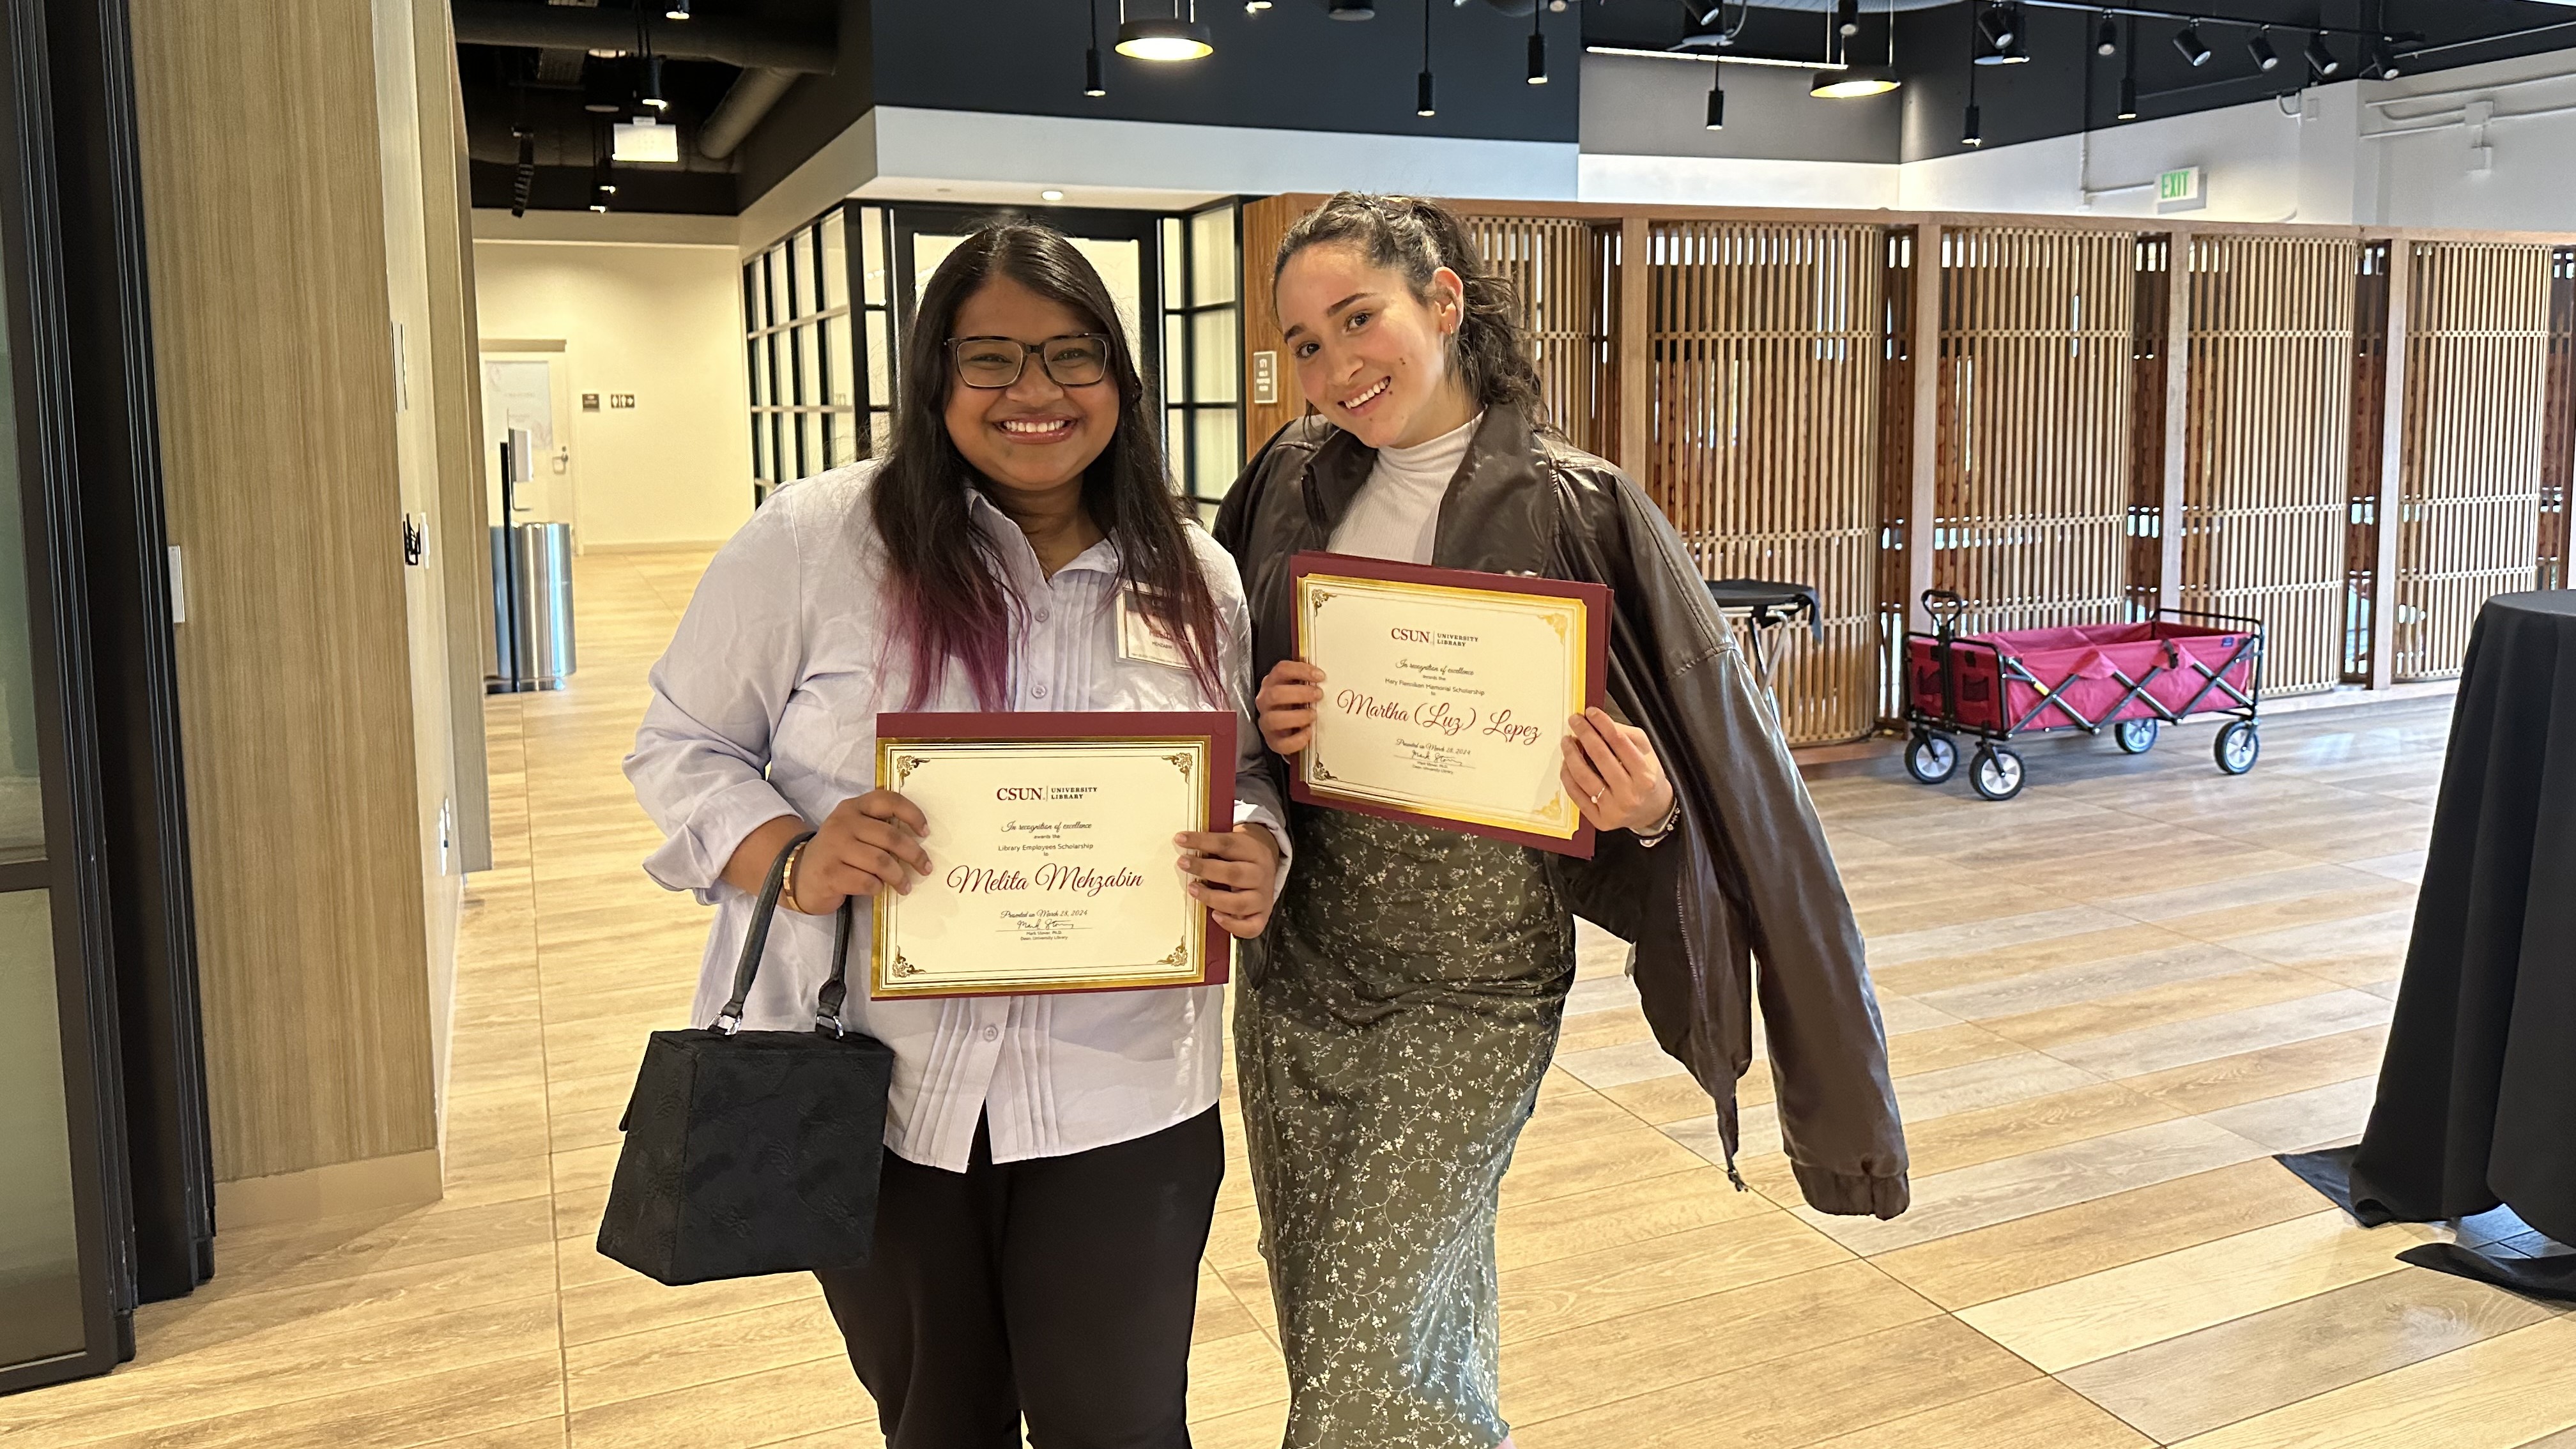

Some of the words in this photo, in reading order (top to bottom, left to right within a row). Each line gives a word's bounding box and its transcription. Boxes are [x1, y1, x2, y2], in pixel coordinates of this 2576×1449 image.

[2161, 171, 2189, 199] EXIT
[1391, 627, 1430, 643] CSUN
[1437, 632, 1478, 643] UNIVERSITY
[1437, 639, 1466, 647] LIBRARY
[1395, 659, 1408, 669] In
[1409, 663, 1439, 673] recognition
[1439, 666, 1448, 675] of
[1448, 667, 1475, 676] excellence
[1452, 686, 1485, 696] Scholarship
[1337, 689, 1409, 721] Martha
[1414, 702, 1476, 736] (Luz)
[1482, 709, 1542, 746] Lopez
[997, 788, 1043, 801] CSUN
[1001, 820, 1016, 832] In
[1019, 822, 1052, 833] recognition
[1054, 822, 1062, 832] of
[1063, 821, 1092, 829] excellence
[946, 865, 1030, 894] Melita
[1035, 862, 1145, 897] Mehzabin
[1000, 910, 1029, 919] Presented
[1036, 909, 1059, 917] March
